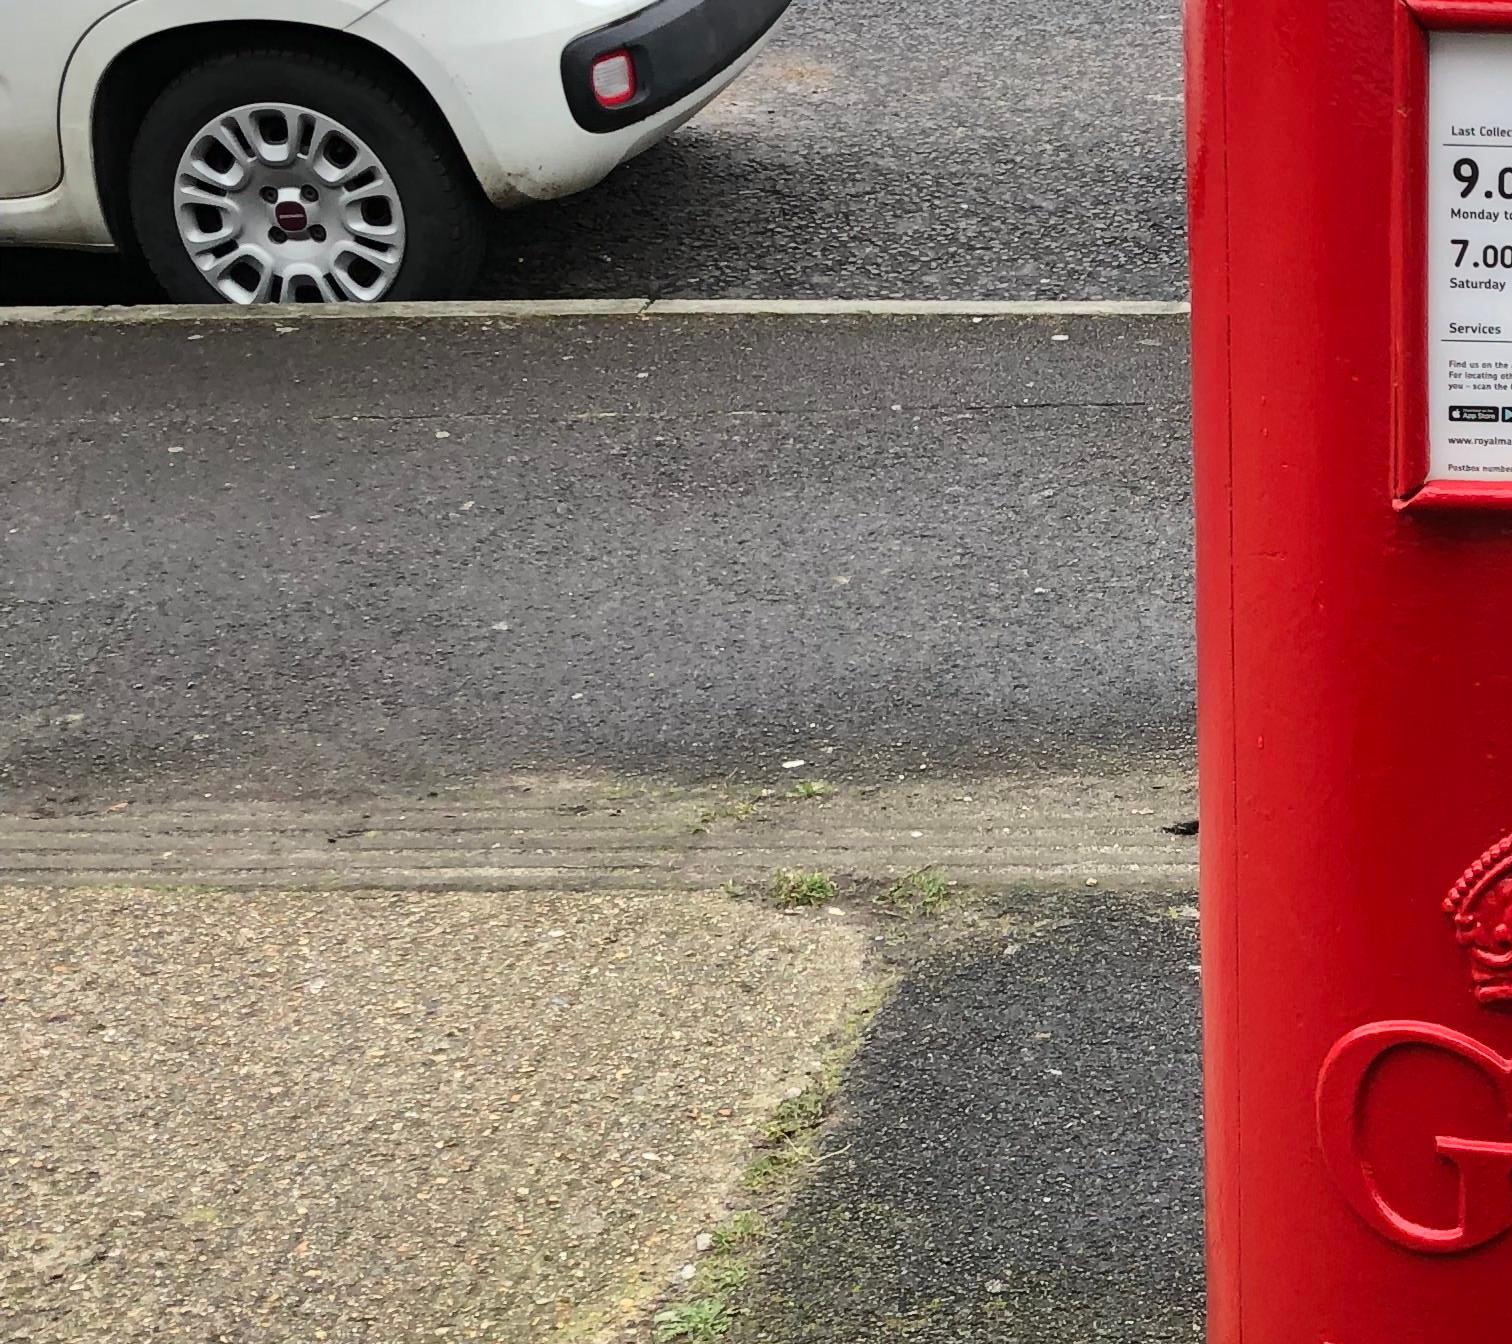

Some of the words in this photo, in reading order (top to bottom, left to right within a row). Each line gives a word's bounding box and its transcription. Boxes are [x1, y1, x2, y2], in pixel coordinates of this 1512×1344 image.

[1452, 126, 1475, 136] Last
[1450, 208, 1500, 222] Monday
[1450, 278, 1506, 292] Saturday
[1449, 323, 1501, 334] Services
[1449, 360, 1466, 368] Find
[1495, 361, 1508, 369] the
[1465, 372, 1497, 381] locating
[1494, 383, 1508, 391] the
[1448, 464, 1479, 472] Postbox
